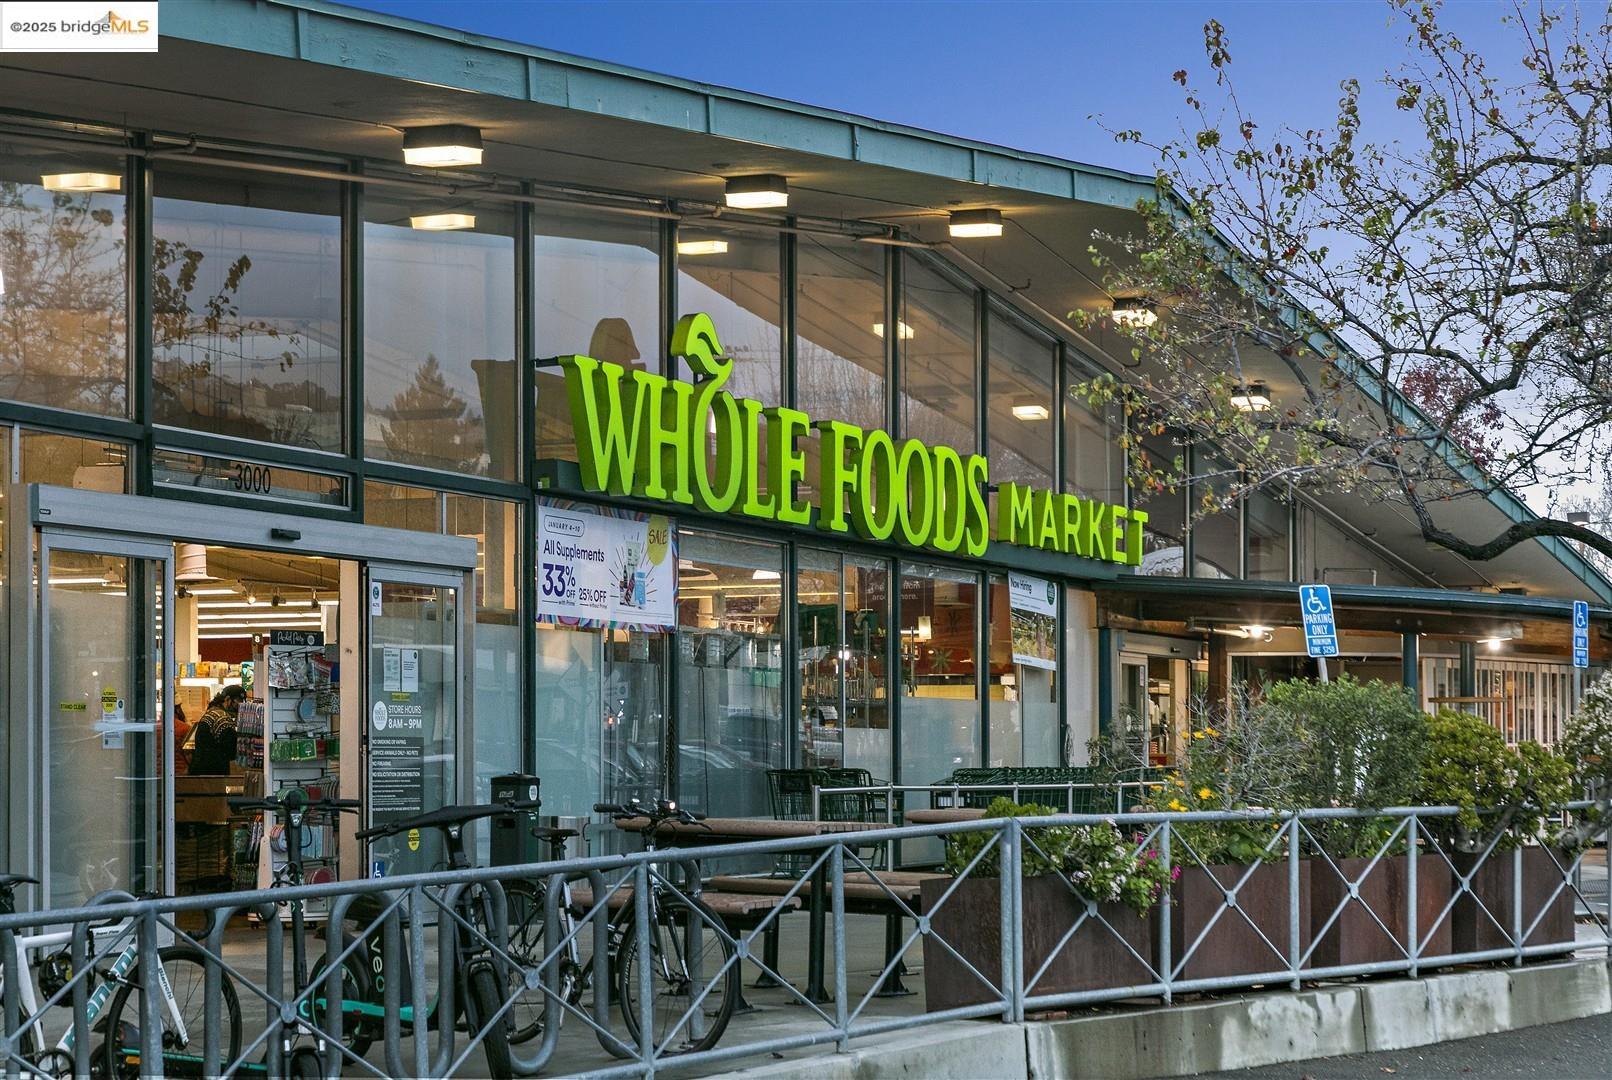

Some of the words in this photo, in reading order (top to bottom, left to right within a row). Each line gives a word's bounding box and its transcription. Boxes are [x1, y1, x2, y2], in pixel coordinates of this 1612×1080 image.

[562, 353, 812, 526] WHOLE
[820, 420, 989, 557] FOODS
[1003, 481, 1149, 567] MARKET
[235, 463, 271, 494] 3000
[548, 521, 568, 531] JANUARY
[648, 529, 668, 545] SALE
[543, 540, 555, 555] All
[556, 542, 605, 562] Supplements
[542, 563, 576, 597] 33%
[1010, 577, 1019, 588] Now
[1020, 580, 1032, 595] Hiring
[566, 589, 576, 599] OFF
[594, 589, 607, 602] OFF
[1305, 613, 1333, 624] PARKING
[1312, 625, 1328, 635] ONLY
[388, 705, 404, 714] STORE
[405, 705, 422, 714] HOURS
[158, 967, 174, 1000] Bianchi
